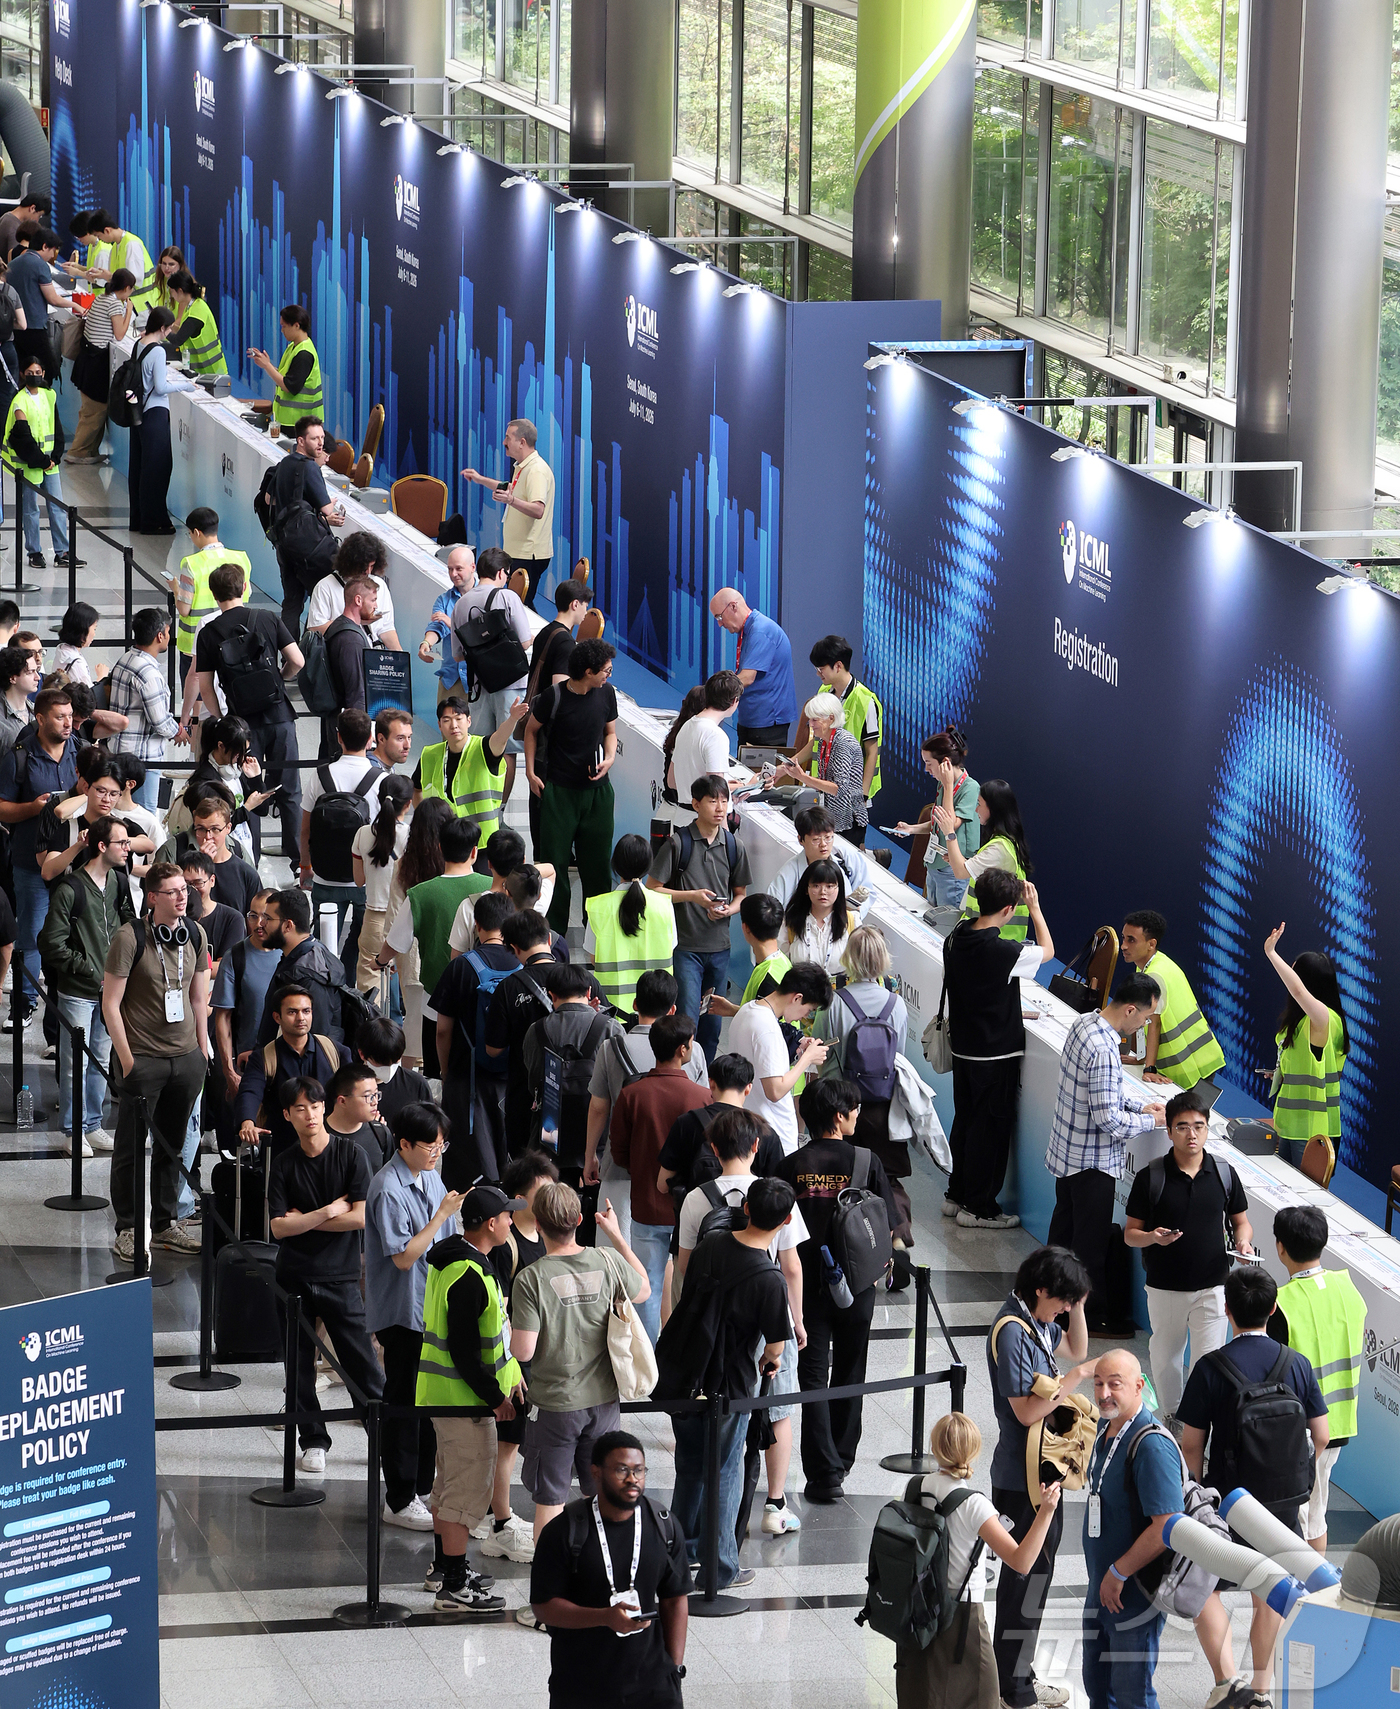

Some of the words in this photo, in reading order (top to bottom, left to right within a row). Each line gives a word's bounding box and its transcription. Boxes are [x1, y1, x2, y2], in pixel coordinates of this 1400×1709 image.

[404, 180, 420, 211] ICML
[638, 302, 659, 339] ICML
[627, 374, 637, 395] Seoul,
[638, 380, 646, 399] South
[648, 385, 657, 404] Korea
[1079, 530, 1112, 578] ICML
[1054, 616, 1118, 688] Registration
[904, 981, 920, 1010] ICML
[797, 1174, 852, 1182] REMEDY
[45, 1324, 84, 1346] ICML
[22, 1364, 88, 1404] BADGE
[1374, 1387, 1388, 1410] Seoul,
[1388, 1398, 1400, 1417] 2026
[22, 1429, 90, 1468] POLICY
[15, 1482, 22, 1492] is
[23, 1474, 54, 1490] required
[55, 1472, 66, 1482] for
[66, 1463, 106, 1480] conference
[107, 1458, 128, 1468] entry.
[22, 1491, 40, 1504] treat
[41, 1488, 58, 1502] your
[58, 1483, 80, 1496] badge
[82, 1480, 96, 1490] like
[96, 1474, 116, 1486] cash.
[22, 1534, 34, 1544] must
[35, 1534, 42, 1542] be
[42, 1526, 68, 1540] purchased
[84, 1518, 102, 1529] current
[102, 1516, 112, 1524] and
[112, 1511, 136, 1522] remaining
[32, 1514, 64, 1528] Replacement
[70, 1510, 78, 1518] Full
[80, 1508, 92, 1516] Price
[10, 1547, 38, 1556] conference
[38, 1540, 60, 1550] sessions
[60, 1537, 68, 1546] you
[70, 1533, 81, 1542] wish
[88, 1528, 104, 1538] attend.
[32, 1552, 42, 1561] will
[48, 1545, 70, 1557] refunded
[70, 1543, 82, 1552] after
[92, 1536, 118, 1546] conference
[118, 1532, 122, 1540] if
[122, 1531, 132, 1540] you
[4, 1568, 15, 1578] both
[16, 1565, 34, 1574] badges
[48, 1554, 76, 1567] registration
[76, 1550, 88, 1560] desk
[89, 1546, 104, 1556] within
[104, 1544, 110, 1553] 24
[112, 1542, 126, 1551] hours.
[22, 1588, 32, 1597] 2nd
[34, 1580, 66, 1594] Replacement
[71, 1576, 80, 1584] Full
[82, 1574, 94, 1582] Price
[24, 1599, 46, 1610] required
[62, 1590, 80, 1601] current
[80, 1588, 90, 1596] and
[90, 1582, 114, 1594] remaining
[114, 1576, 140, 1588] conference
[16, 1614, 26, 1624] you
[26, 1610, 38, 1620] wish
[44, 1604, 62, 1616] attend.
[70, 1598, 88, 1609] refunds
[88, 1595, 98, 1604] will
[105, 1589, 122, 1600] issued.
[18, 1649, 38, 1661] scuffed
[38, 1646, 56, 1656] badges
[56, 1642, 66, 1651] will
[66, 1642, 72, 1650] be
[72, 1634, 94, 1647] replaced
[94, 1634, 104, 1642] free
[104, 1630, 110, 1639] of
[110, 1628, 128, 1637] charge.
[22, 1636, 38, 1646] Badge
[38, 1628, 70, 1642] Replacement
[76, 1622, 96, 1632] Updates
[14, 1664, 26, 1672] may
[33, 1656, 52, 1668] updated
[54, 1654, 62, 1662] due
[74, 1646, 92, 1656] change
[92, 1644, 98, 1652] of
[98, 1639, 122, 1651] institution.
